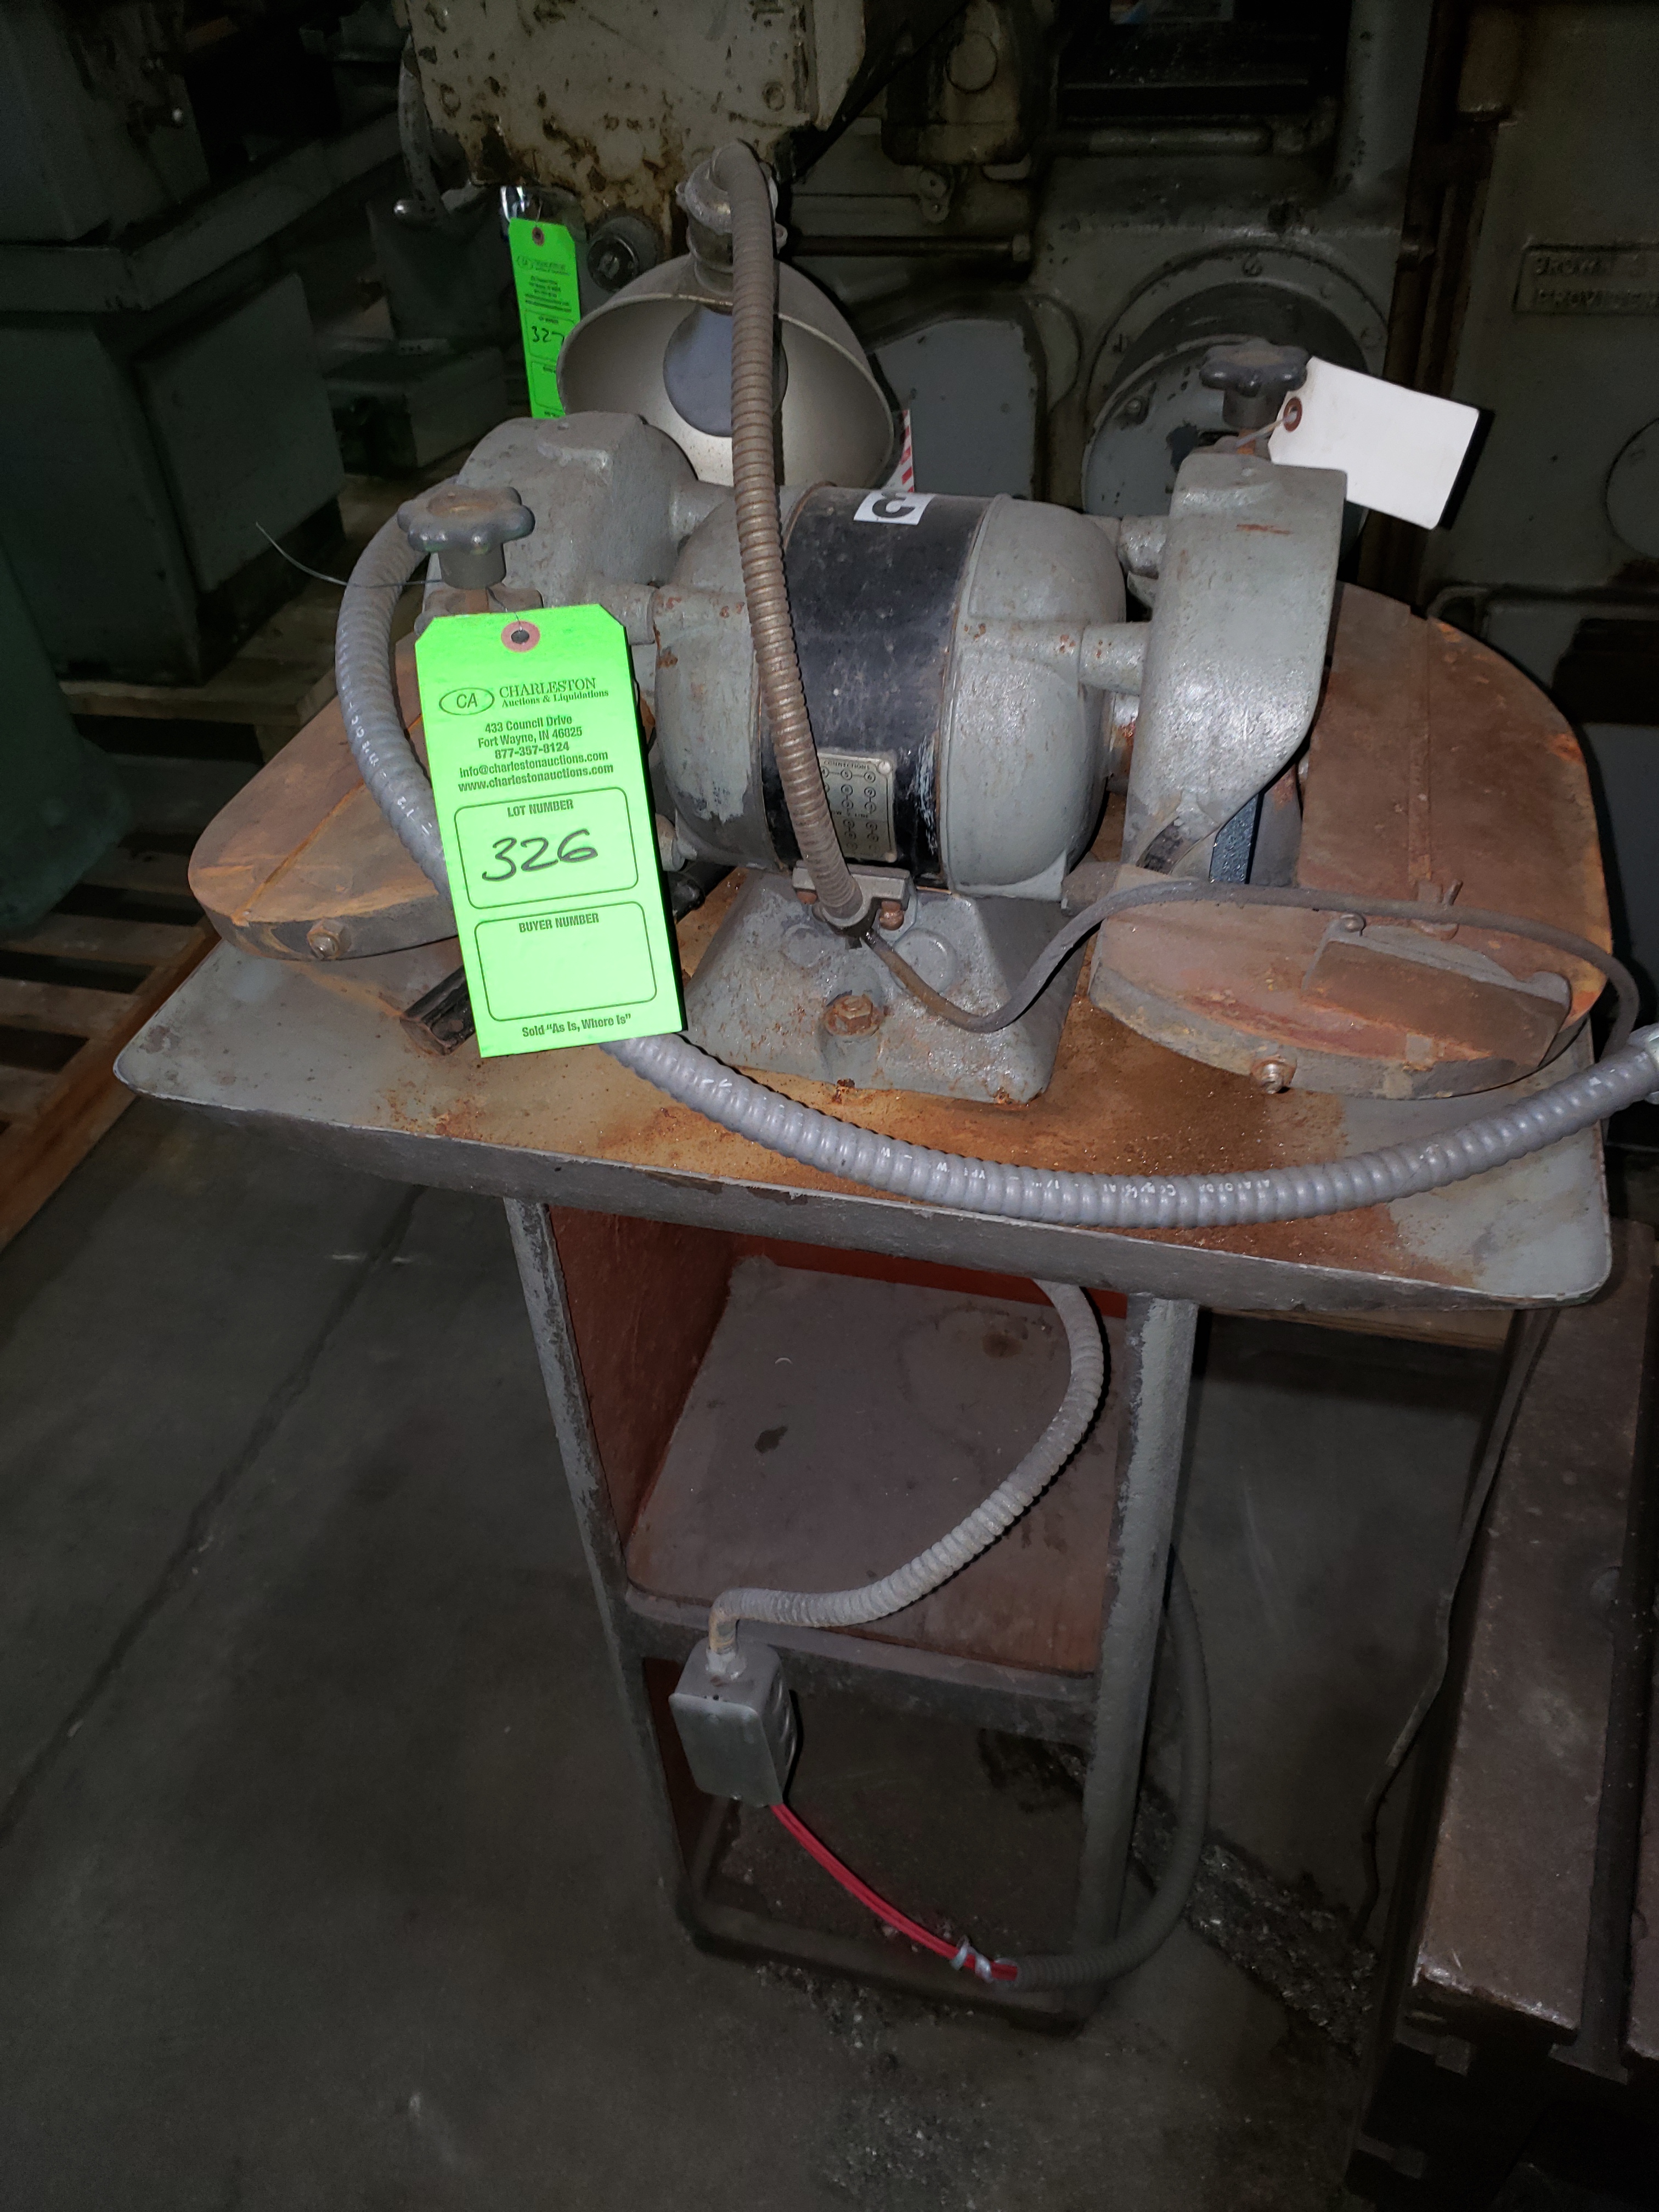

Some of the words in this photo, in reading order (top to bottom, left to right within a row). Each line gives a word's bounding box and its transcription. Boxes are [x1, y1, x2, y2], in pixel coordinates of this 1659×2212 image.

[499, 677, 596, 698] CHARLESTON
[456, 692, 478, 709] CA
[502, 697, 540, 708] Auctions
[542, 695, 551, 703] &
[553, 689, 609, 703] Liquidations
[485, 721, 504, 733] 433
[506, 716, 543, 731] Council
[546, 714, 572, 727] Drive
[478, 735, 499, 748] Fort
[500, 733, 537, 746] Wayne,
[538, 729, 550, 741] IN
[495, 741, 570, 760] 877-357-8124
[458, 764, 614, 792] www.charlestonauctions.com
[507, 805, 526, 817] LOT
[528, 799, 574, 815] NUMBER
[482, 828, 598, 882] 326
[518, 919, 553, 933] BUYER
[555, 912, 600, 928] NUMBER
[522, 1024, 545, 1037] Sold
[567, 1021, 580, 1032] Is,
[581, 1017, 614, 1030] Where
